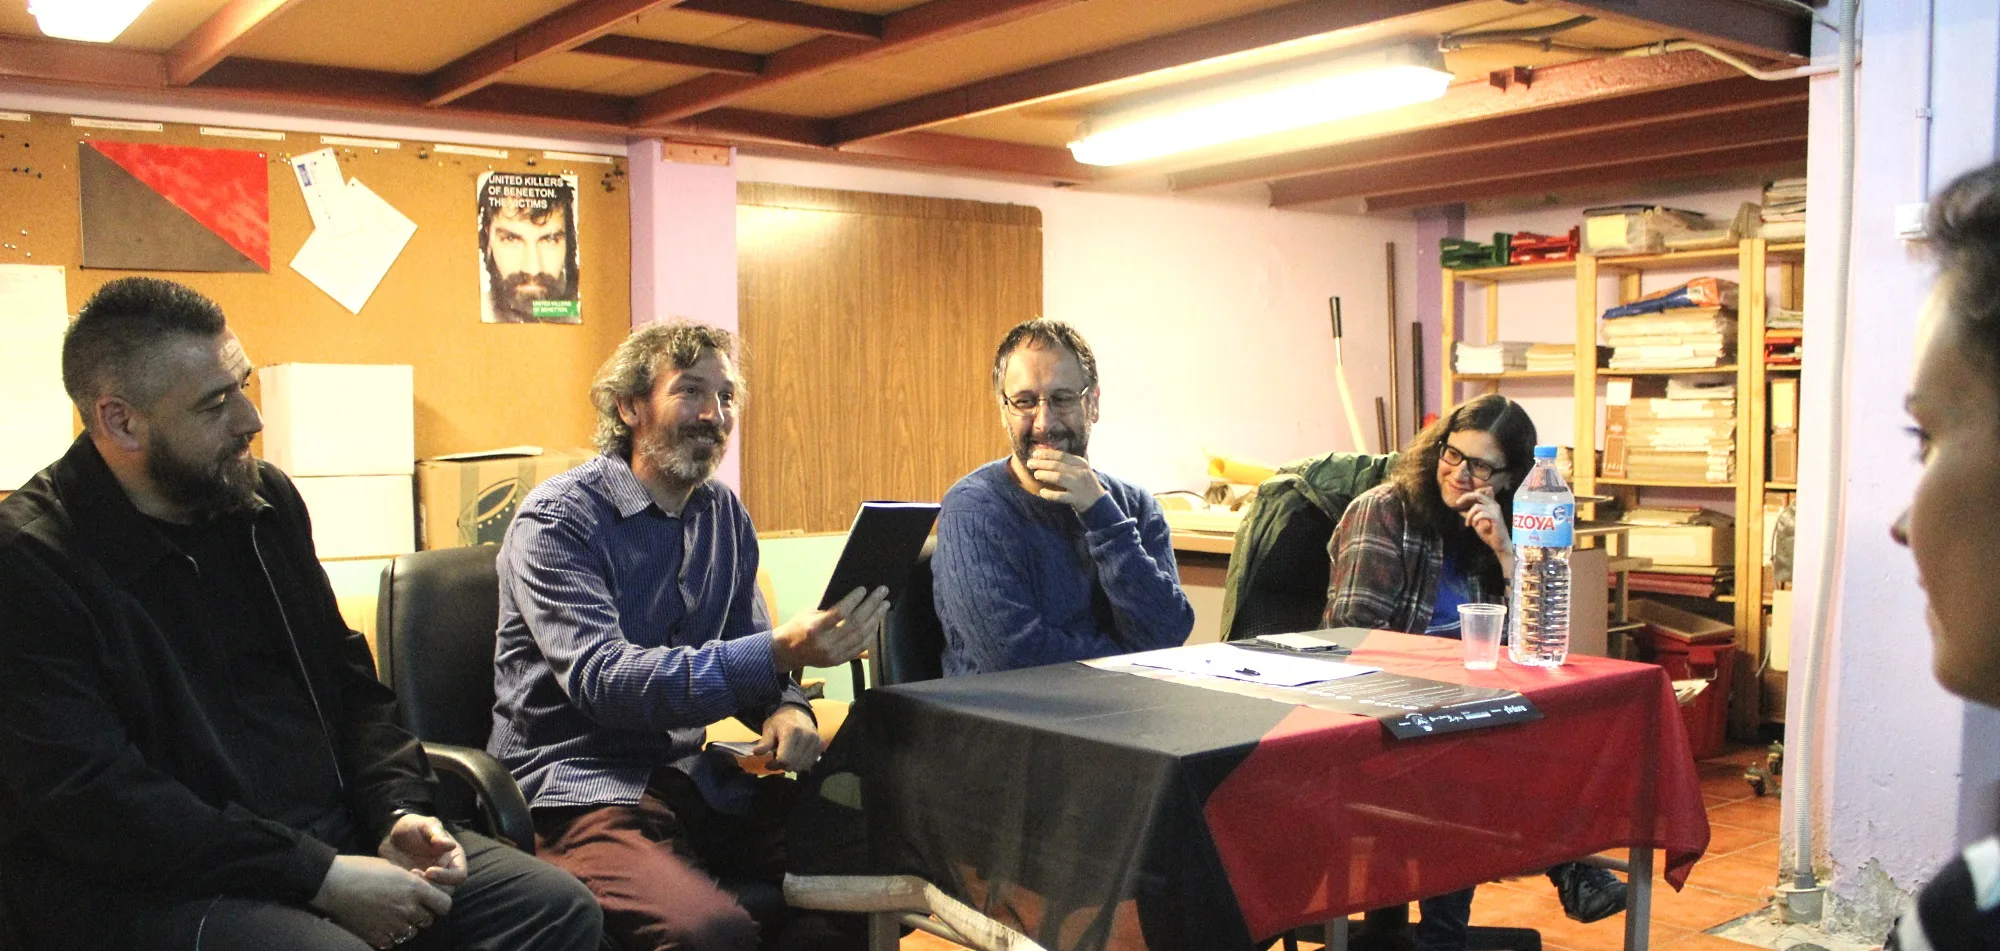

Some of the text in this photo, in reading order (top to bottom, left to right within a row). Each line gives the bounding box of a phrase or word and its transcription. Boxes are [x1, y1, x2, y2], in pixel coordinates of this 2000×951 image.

[488, 175, 564, 187] UNITED KILLERS
[488, 186, 501, 195] OF
[488, 197, 548, 209] THE VICTIMS
